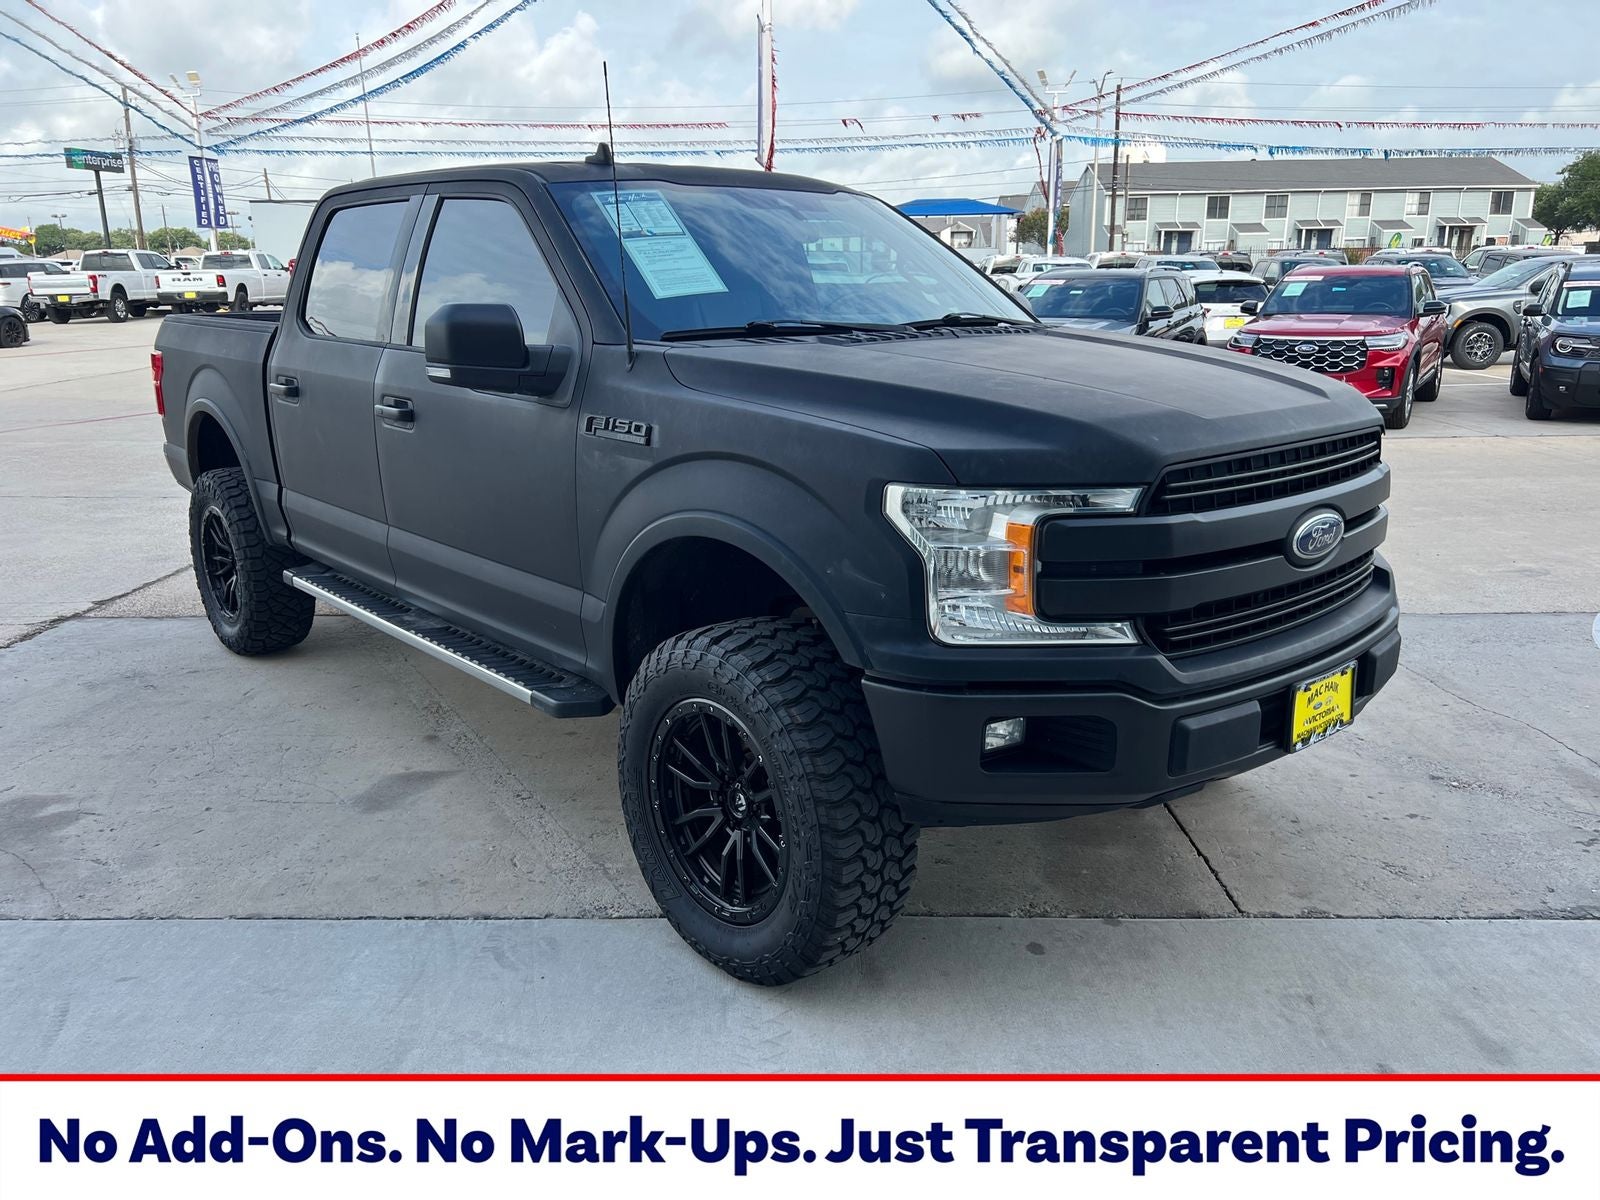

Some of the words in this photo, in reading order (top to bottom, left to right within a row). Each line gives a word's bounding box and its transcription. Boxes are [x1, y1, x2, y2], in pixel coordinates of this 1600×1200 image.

[193, 159, 208, 225] CERTIFIED
[213, 173, 226, 225] OWNED
[1308, 523, 1336, 551] Ford
[1306, 683, 1324, 708] MAC
